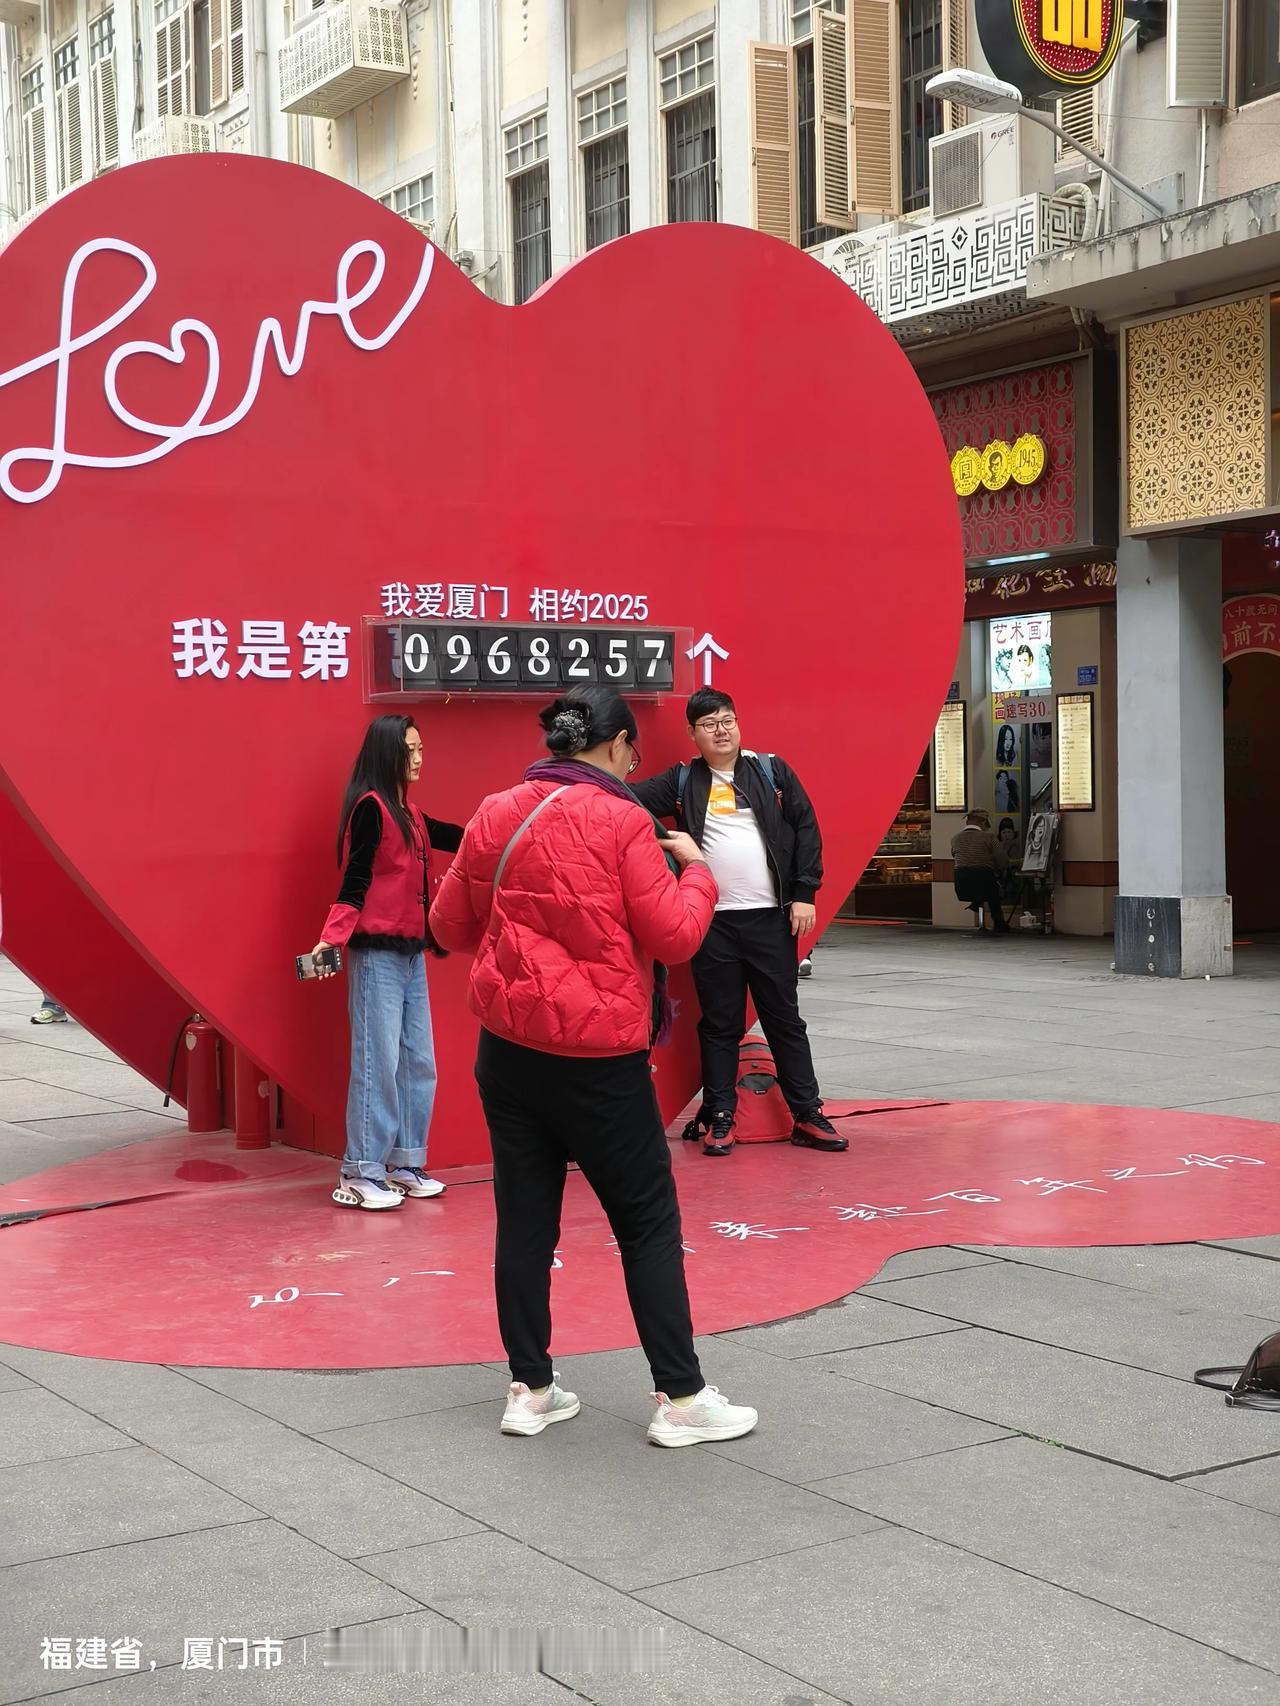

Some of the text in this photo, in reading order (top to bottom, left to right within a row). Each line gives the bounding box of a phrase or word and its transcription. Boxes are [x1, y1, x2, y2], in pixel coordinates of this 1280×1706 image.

[0, 237, 434, 503] Love
[1018, 449, 1036, 468] 1945
[380, 582, 649, 622] 我爱厦门 相约2025
[172, 617, 731, 686] 我是第 0968257 个
